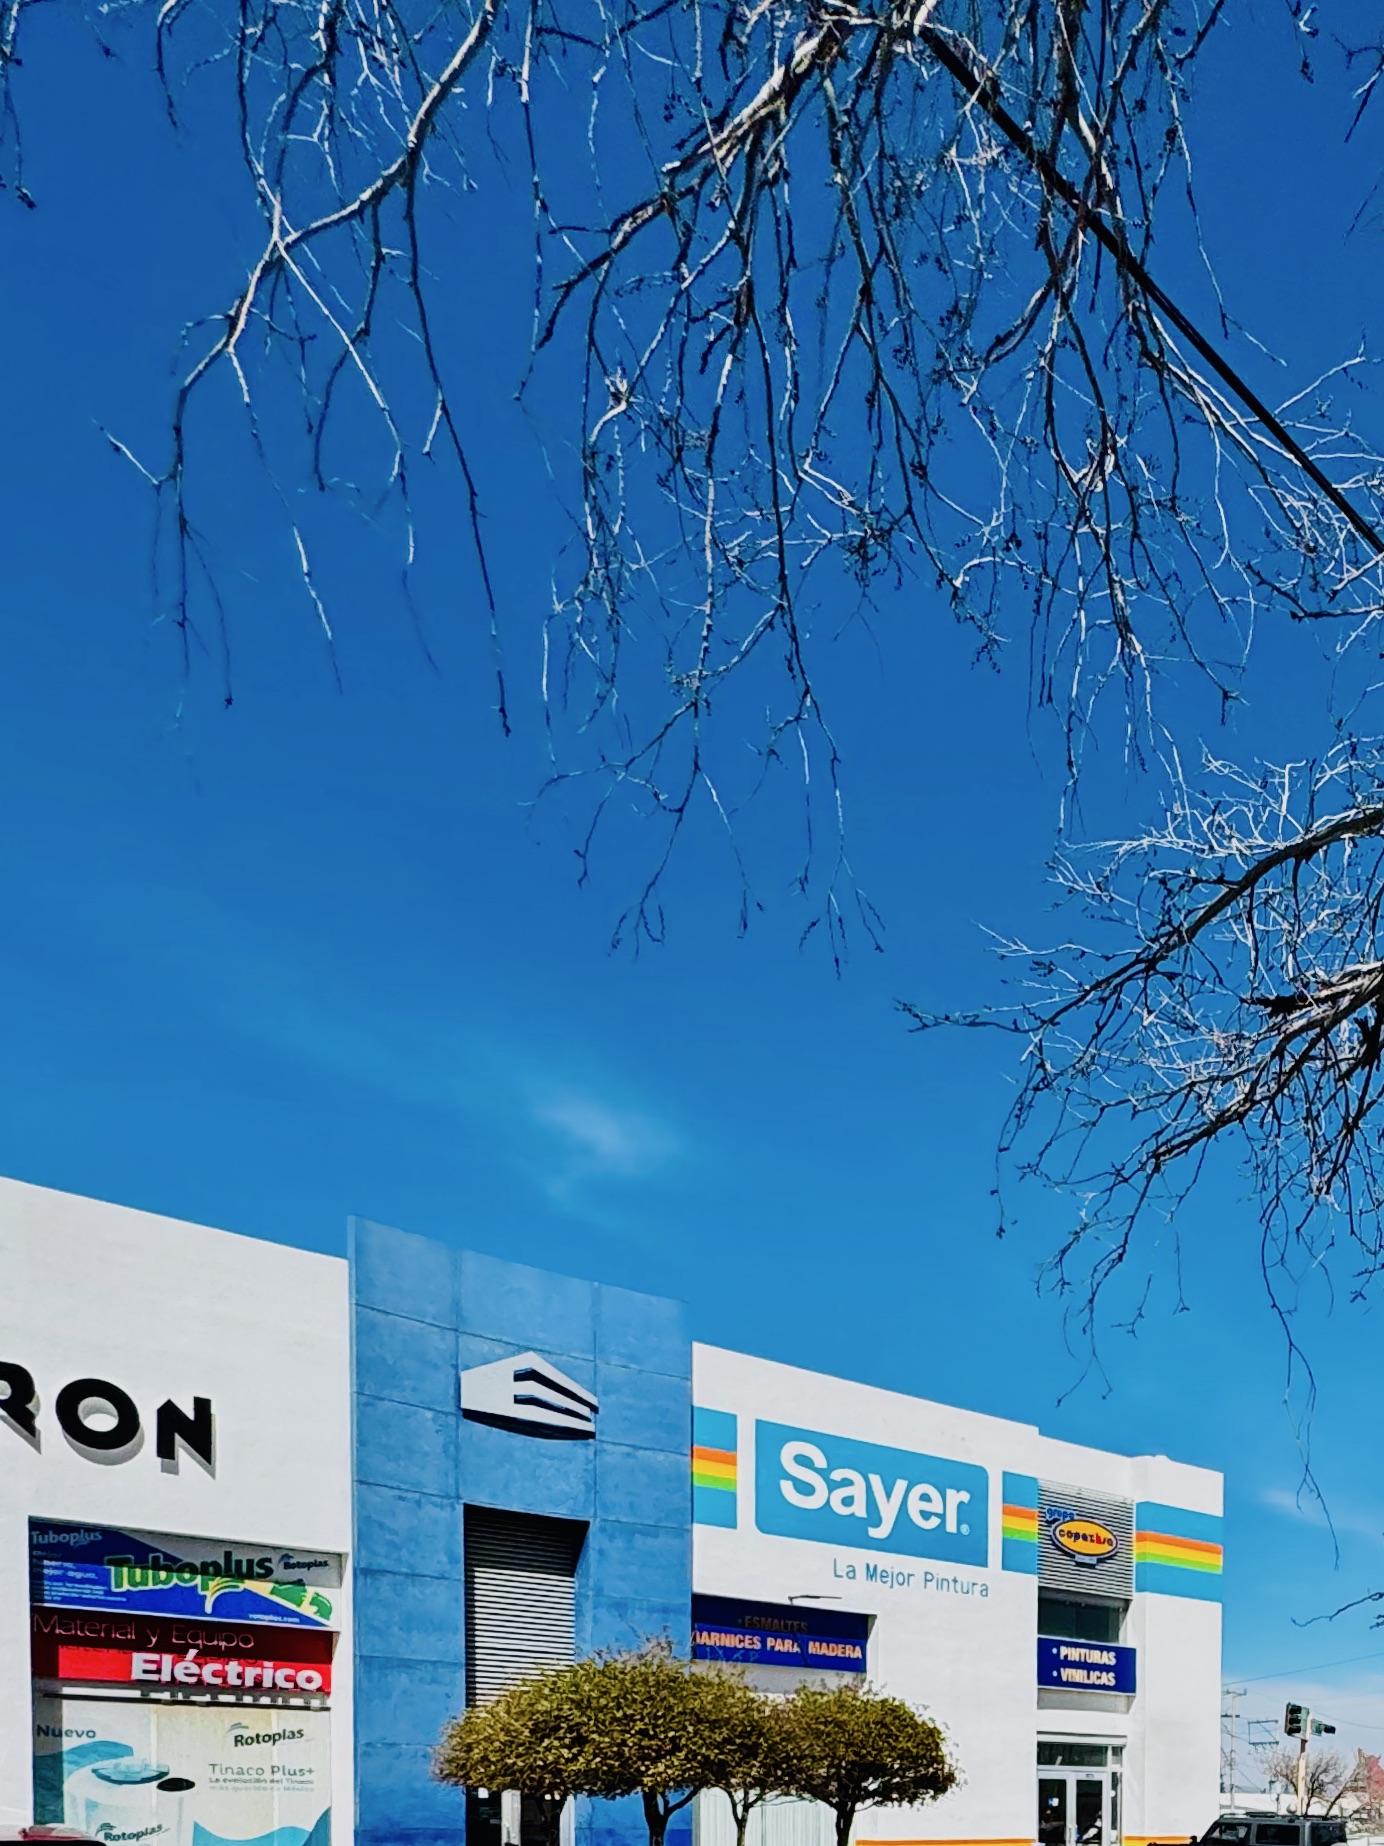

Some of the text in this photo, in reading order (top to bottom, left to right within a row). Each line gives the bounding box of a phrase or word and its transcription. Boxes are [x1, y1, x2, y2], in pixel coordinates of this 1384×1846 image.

[31, 1529, 103, 1547] Tuboplus
[104, 1551, 274, 1614] Tuboplus
[833, 1558, 989, 1598] La Mejor Pintura
[33, 1613, 255, 1650] Material y Equipo
[744, 1615, 808, 1633] ESMALTES
[766, 1637, 801, 1654] PARA
[808, 1641, 863, 1659] MADERA
[1060, 1646, 1116, 1666] PINTURAS
[131, 1649, 323, 1691] Eléctrico
[1060, 1667, 1116, 1686] VINILICAS
[36, 1724, 97, 1738] Nuevo
[234, 1729, 305, 1747] Rotoplas
[208, 1763, 265, 1776] Tinaco
[104, 1823, 164, 1842] Rotoplas
